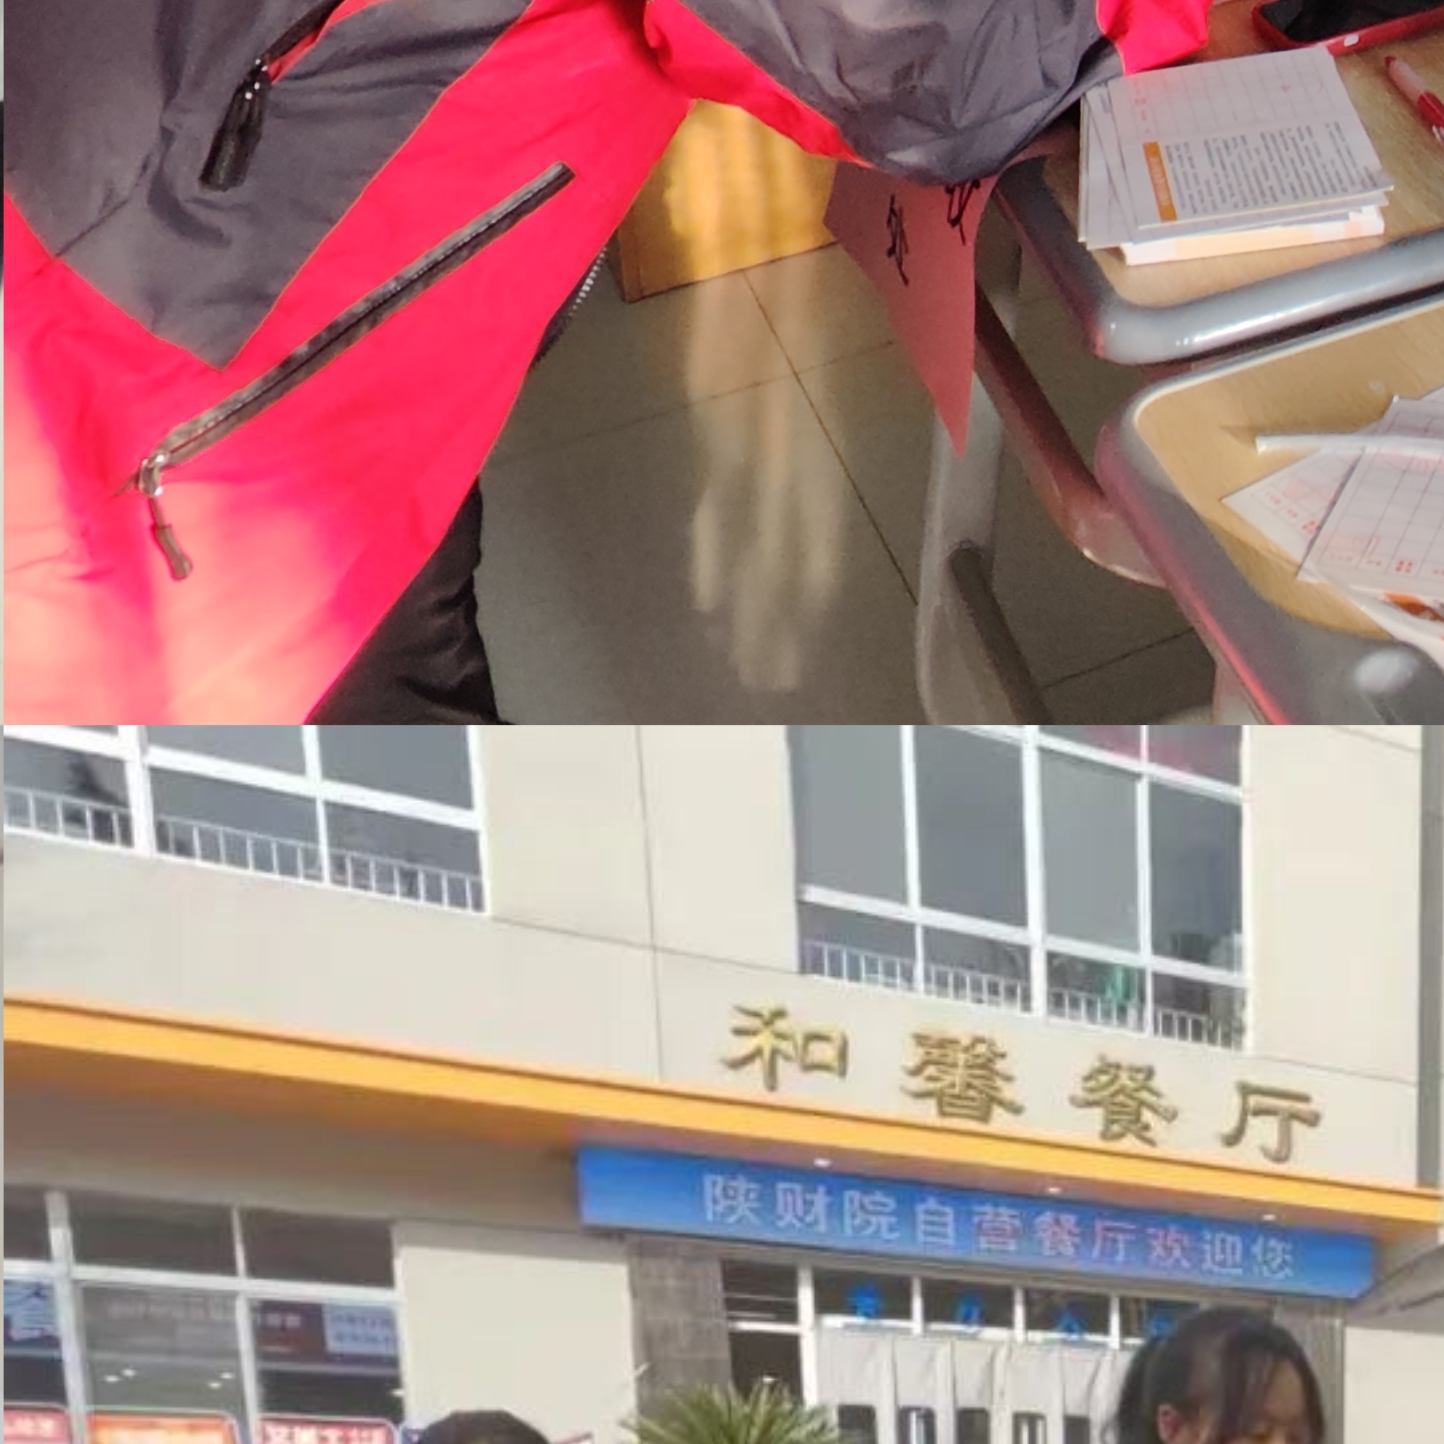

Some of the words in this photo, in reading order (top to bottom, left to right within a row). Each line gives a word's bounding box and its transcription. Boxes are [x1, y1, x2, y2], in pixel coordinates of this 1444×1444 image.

[720, 1002, 1323, 1163] 和馨餐厅
[702, 1171, 1296, 1281] 陕财院自营餐厅欢迎您
